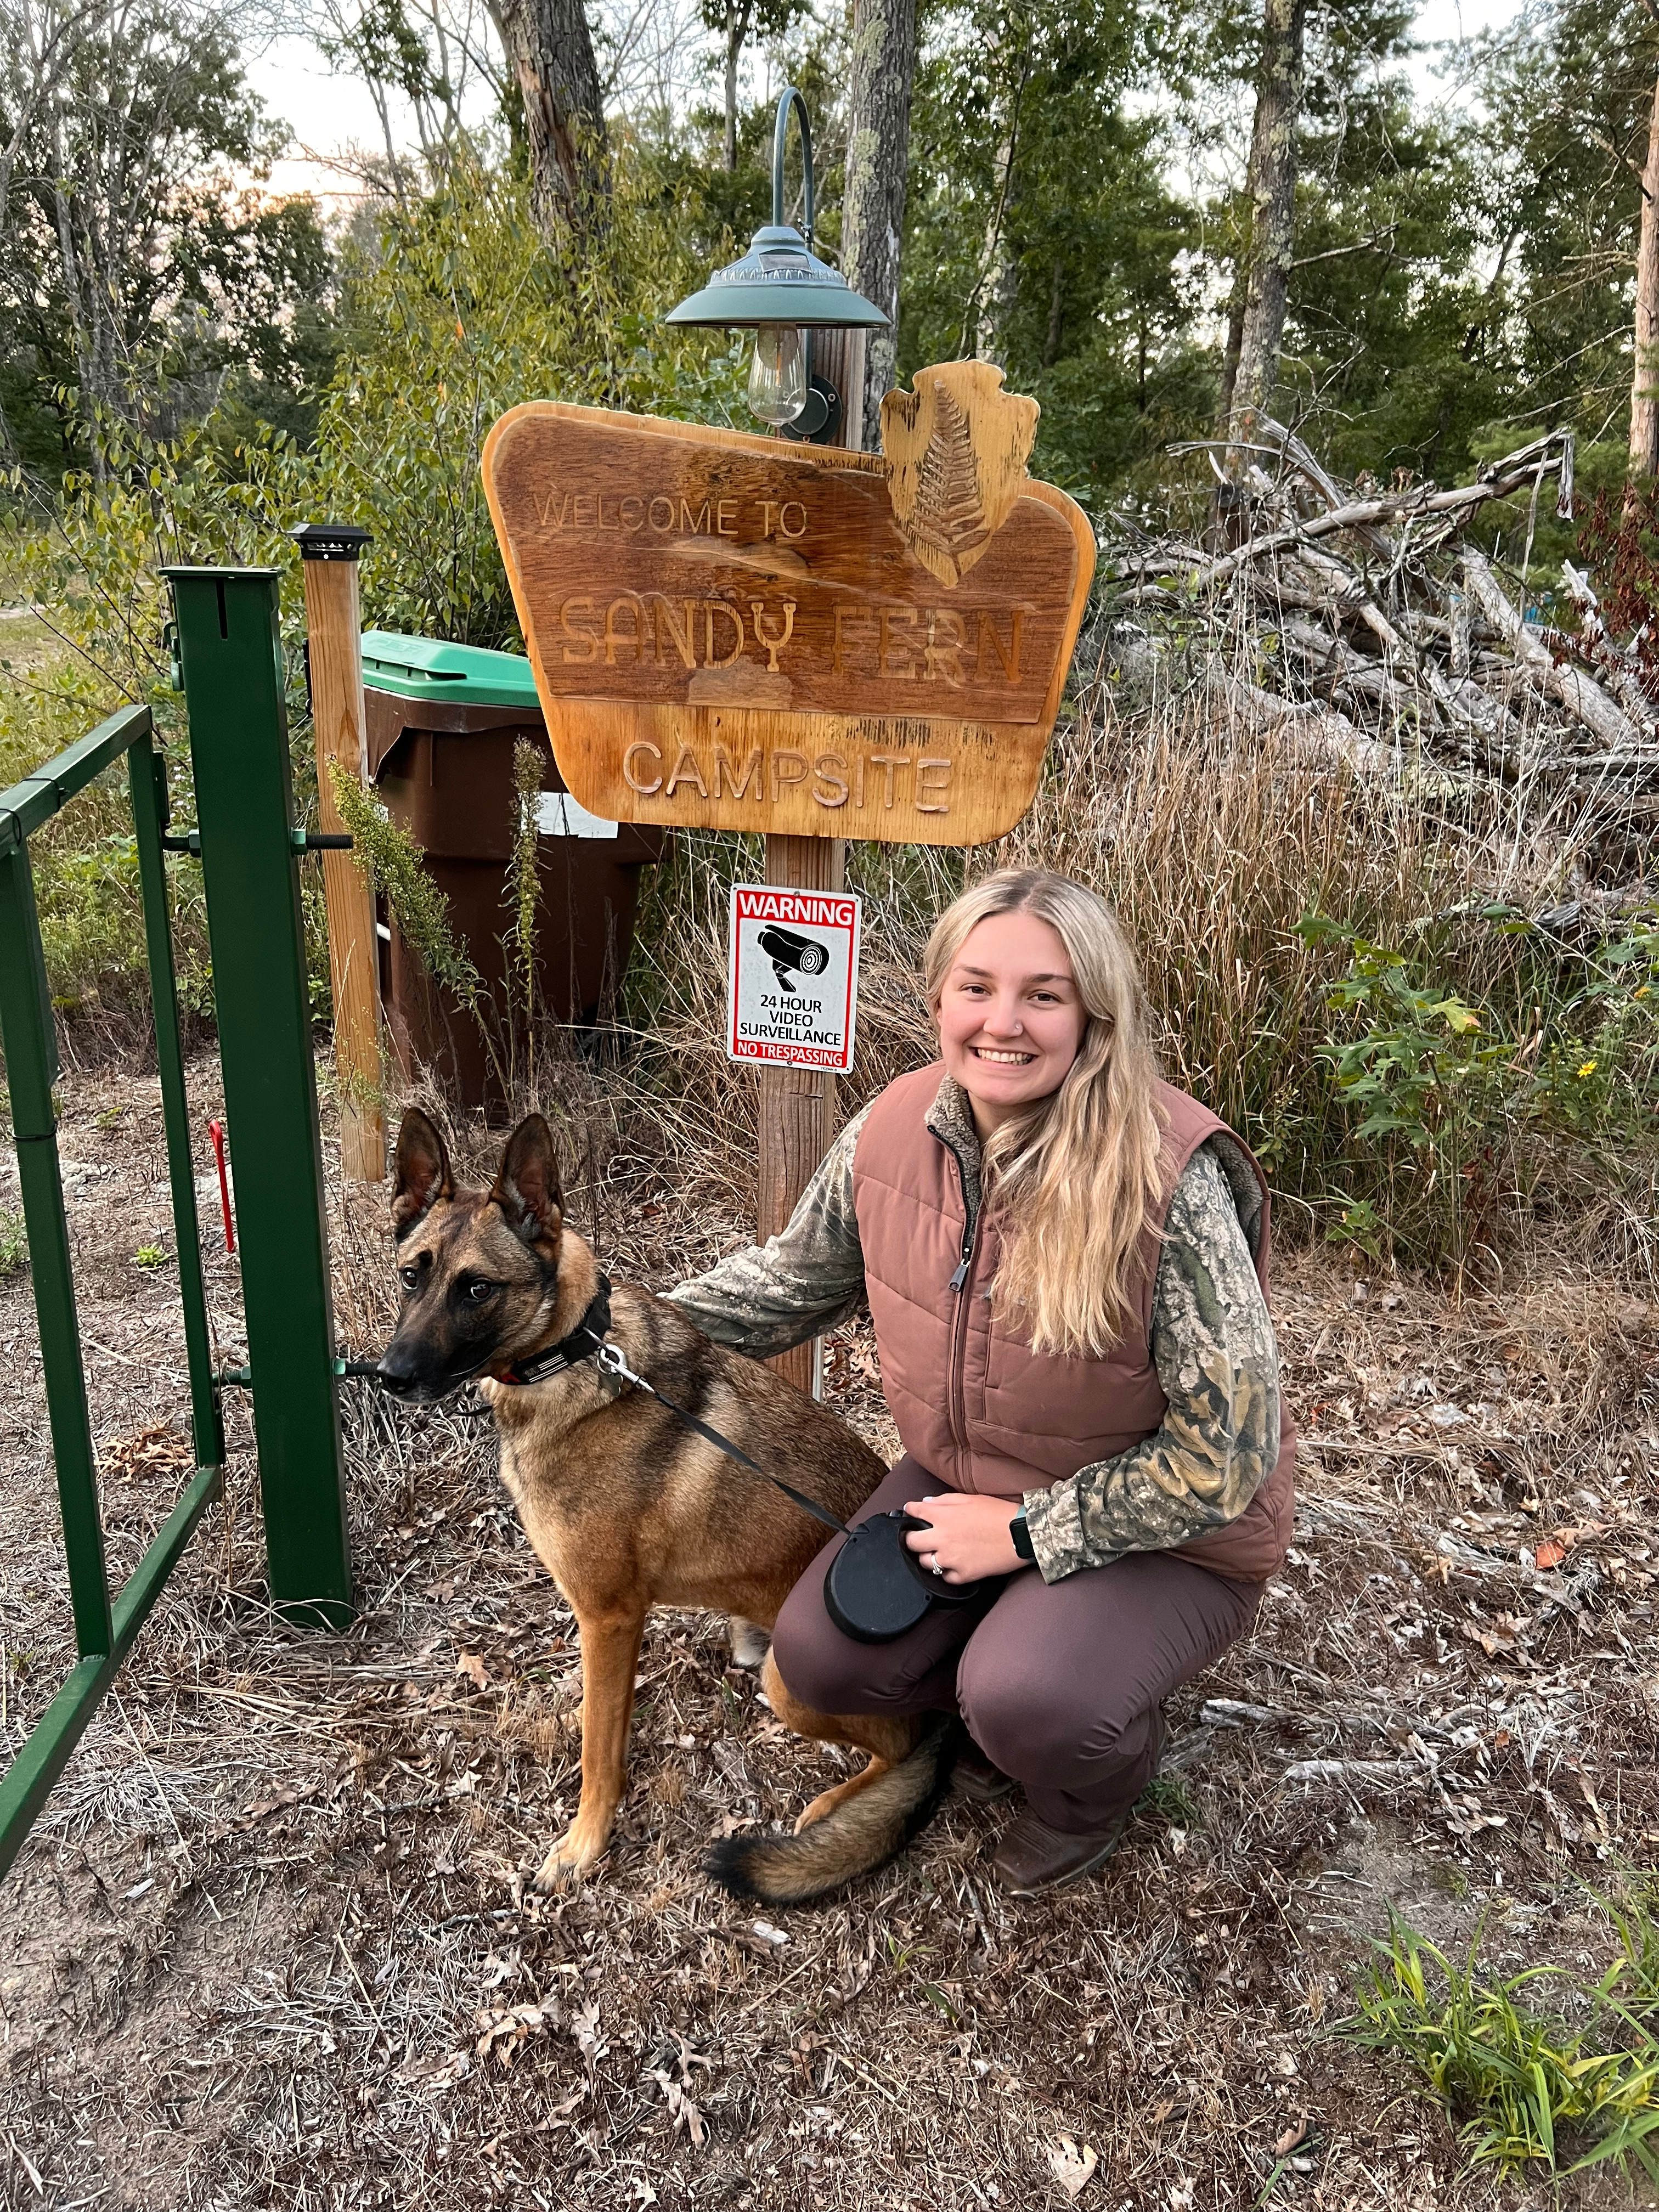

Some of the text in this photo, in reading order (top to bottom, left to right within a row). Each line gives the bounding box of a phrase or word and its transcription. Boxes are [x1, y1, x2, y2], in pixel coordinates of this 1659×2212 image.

[533, 493, 808, 538] WELCOME TO
[560, 595, 1025, 684] SANDY FERN
[623, 741, 952, 813] CAMPSITE
[739, 893, 853, 926] WARNING
[760, 994, 822, 1014] 24 HOUR
[769, 1010, 813, 1027] VIDEO
[740, 1022, 842, 1046] SURVEILLANCE
[737, 1041, 843, 1066] NO TRESPASSING
